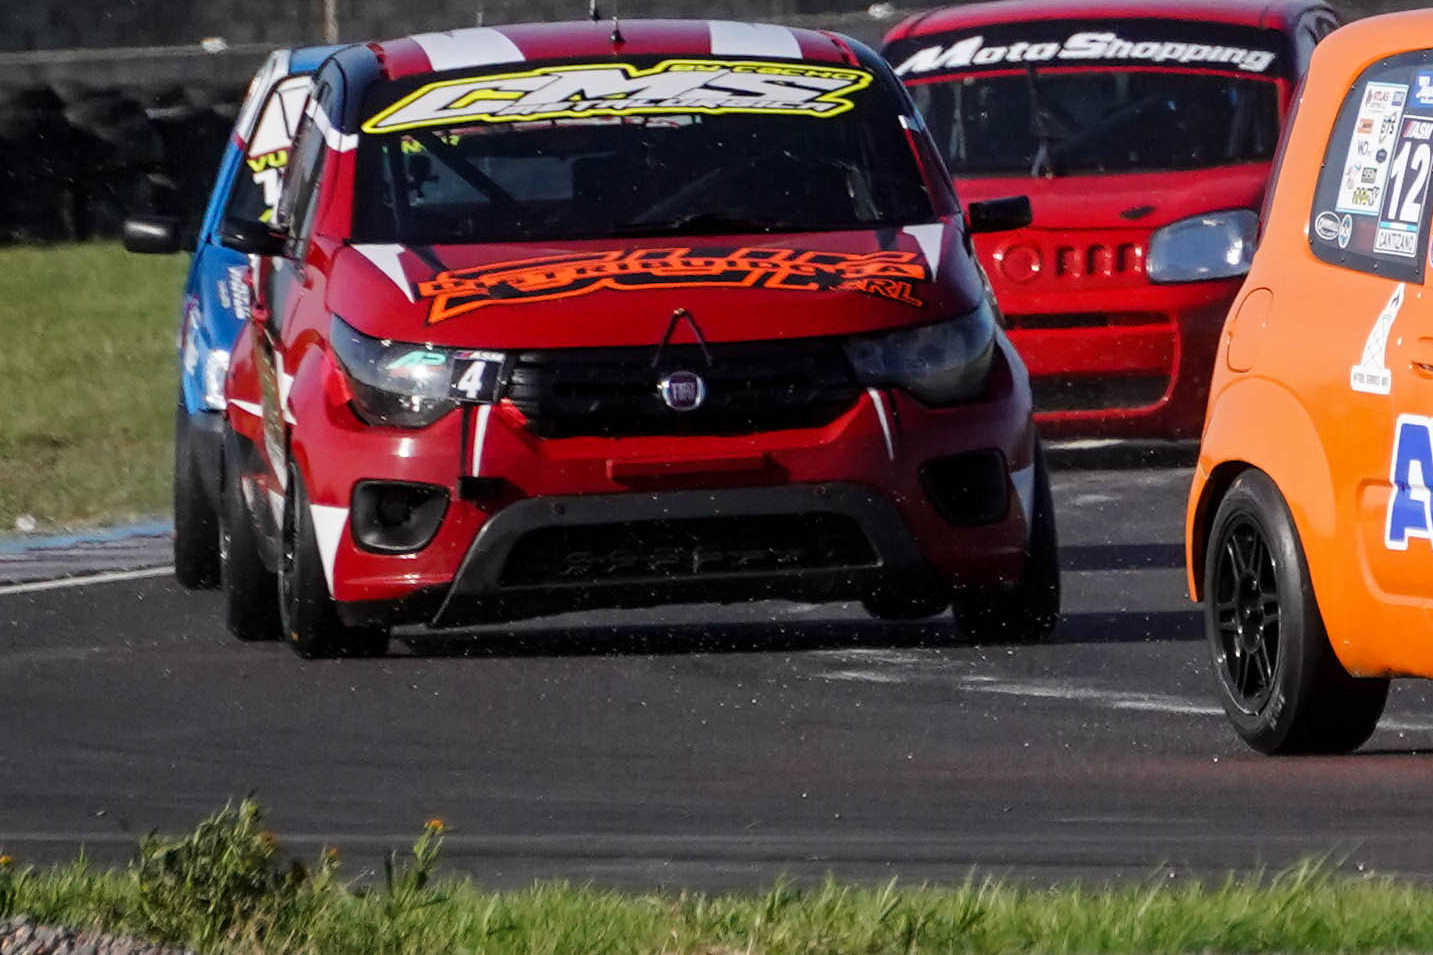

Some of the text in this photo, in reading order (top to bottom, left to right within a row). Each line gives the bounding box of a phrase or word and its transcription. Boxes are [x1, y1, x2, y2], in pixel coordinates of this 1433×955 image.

[376, 67, 855, 128] CMS
[1390, 140, 1431, 223] 12
[457, 361, 486, 399] 4
